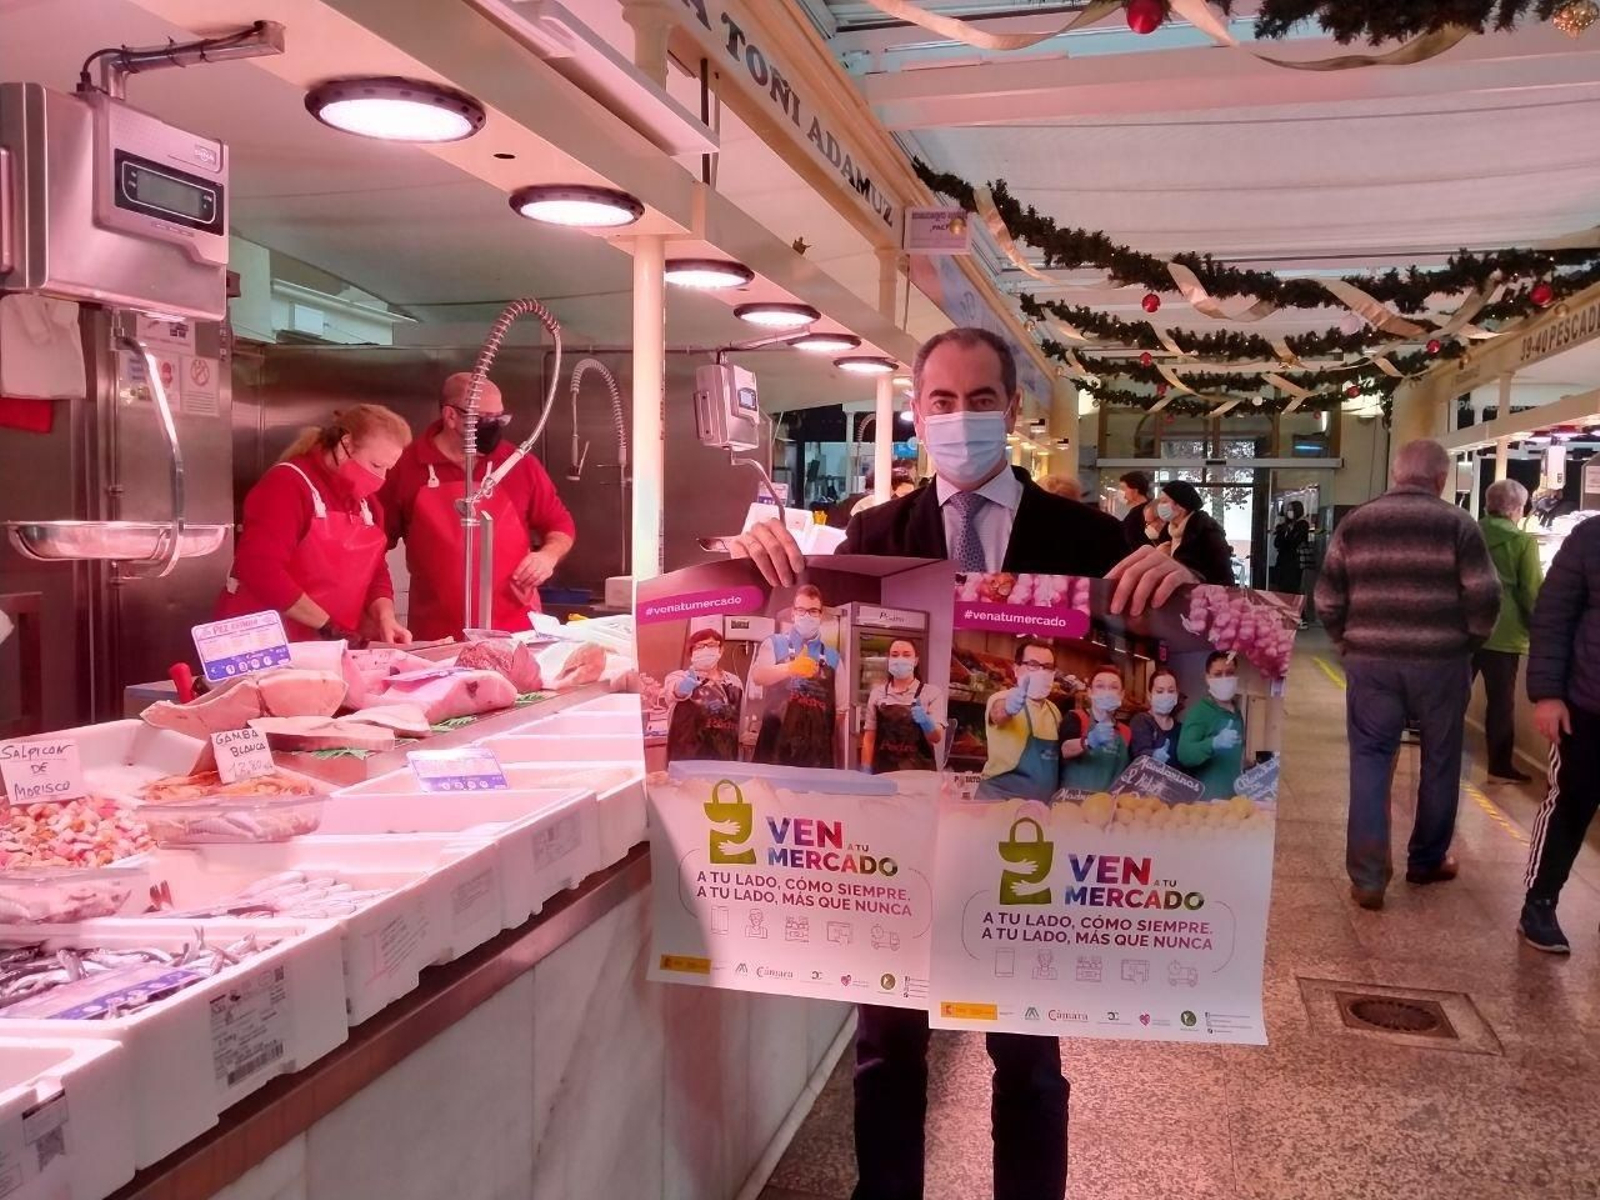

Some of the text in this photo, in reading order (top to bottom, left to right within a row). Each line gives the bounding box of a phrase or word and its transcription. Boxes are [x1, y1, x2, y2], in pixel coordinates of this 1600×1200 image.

[721, 12, 801, 128] TOÑI
[806, 116, 893, 228] ADAMUZ
[645, 595, 742, 617] #venatumercado
[964, 609, 1066, 627] #venatumercado
[215, 728, 259, 745] GAMBA
[0, 744, 75, 760] SALPICON
[30, 762, 49, 774] DE
[766, 816, 843, 849] VEN
[855, 844, 870, 853] TU
[768, 847, 899, 877] MERCADO
[1068, 853, 1152, 886] VEN
[1162, 879, 1177, 888] TU
[697, 870, 707, 883] A
[710, 871, 731, 884] TU
[735, 873, 781, 890] LADO,
[785, 874, 833, 893] CÓMO
[697, 886, 912, 917] A TU LADO, MÁS QUE NUNCA
[1064, 886, 1205, 911] MERCADO
[983, 912, 994, 925] A
[998, 912, 1021, 925] TU
[1026, 914, 1076, 930] LADO,
[1081, 913, 1132, 932] CÓMO
[981, 927, 1213, 951] A TU LADO, MÁS QUE NUNCA
